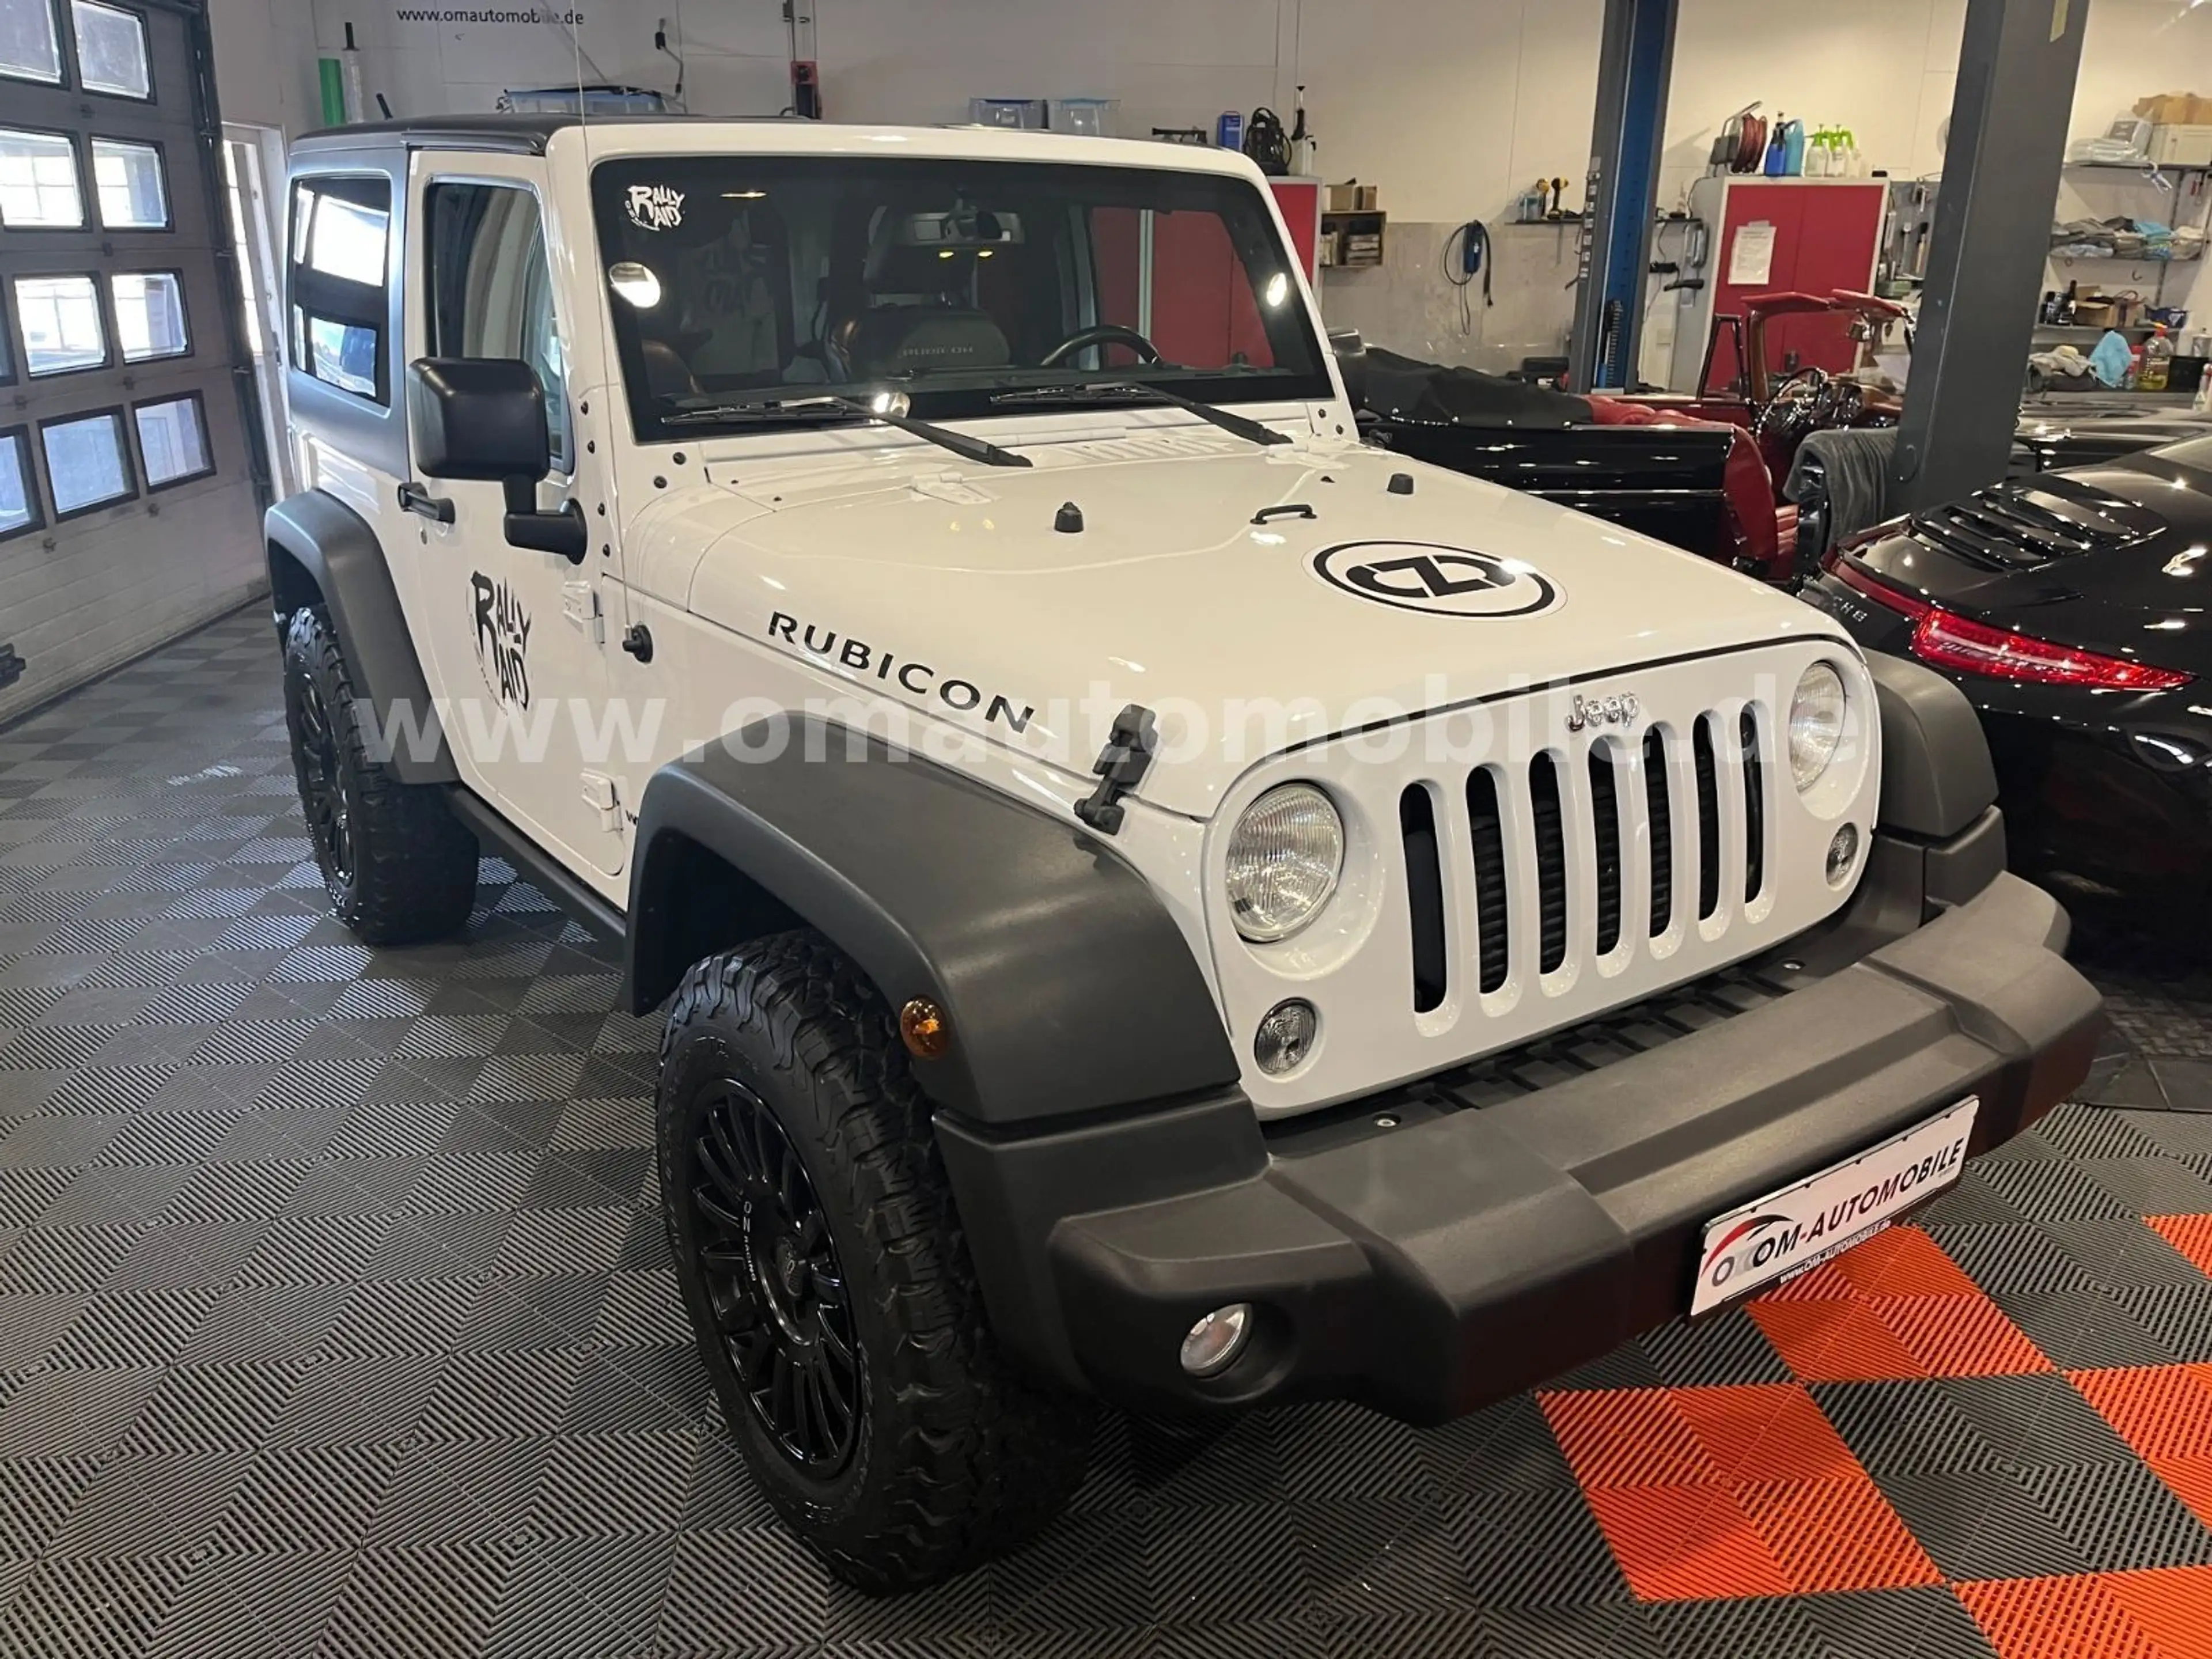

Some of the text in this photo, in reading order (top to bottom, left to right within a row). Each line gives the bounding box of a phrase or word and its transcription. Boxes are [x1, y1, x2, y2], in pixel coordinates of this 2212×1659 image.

[396, 7, 584, 25] www.omautomob.de
[768, 611, 1035, 733] RUBICON
[1565, 692, 1639, 732] Jeep
[1752, 1137, 1964, 1268] OM-AUTOMOBILE
